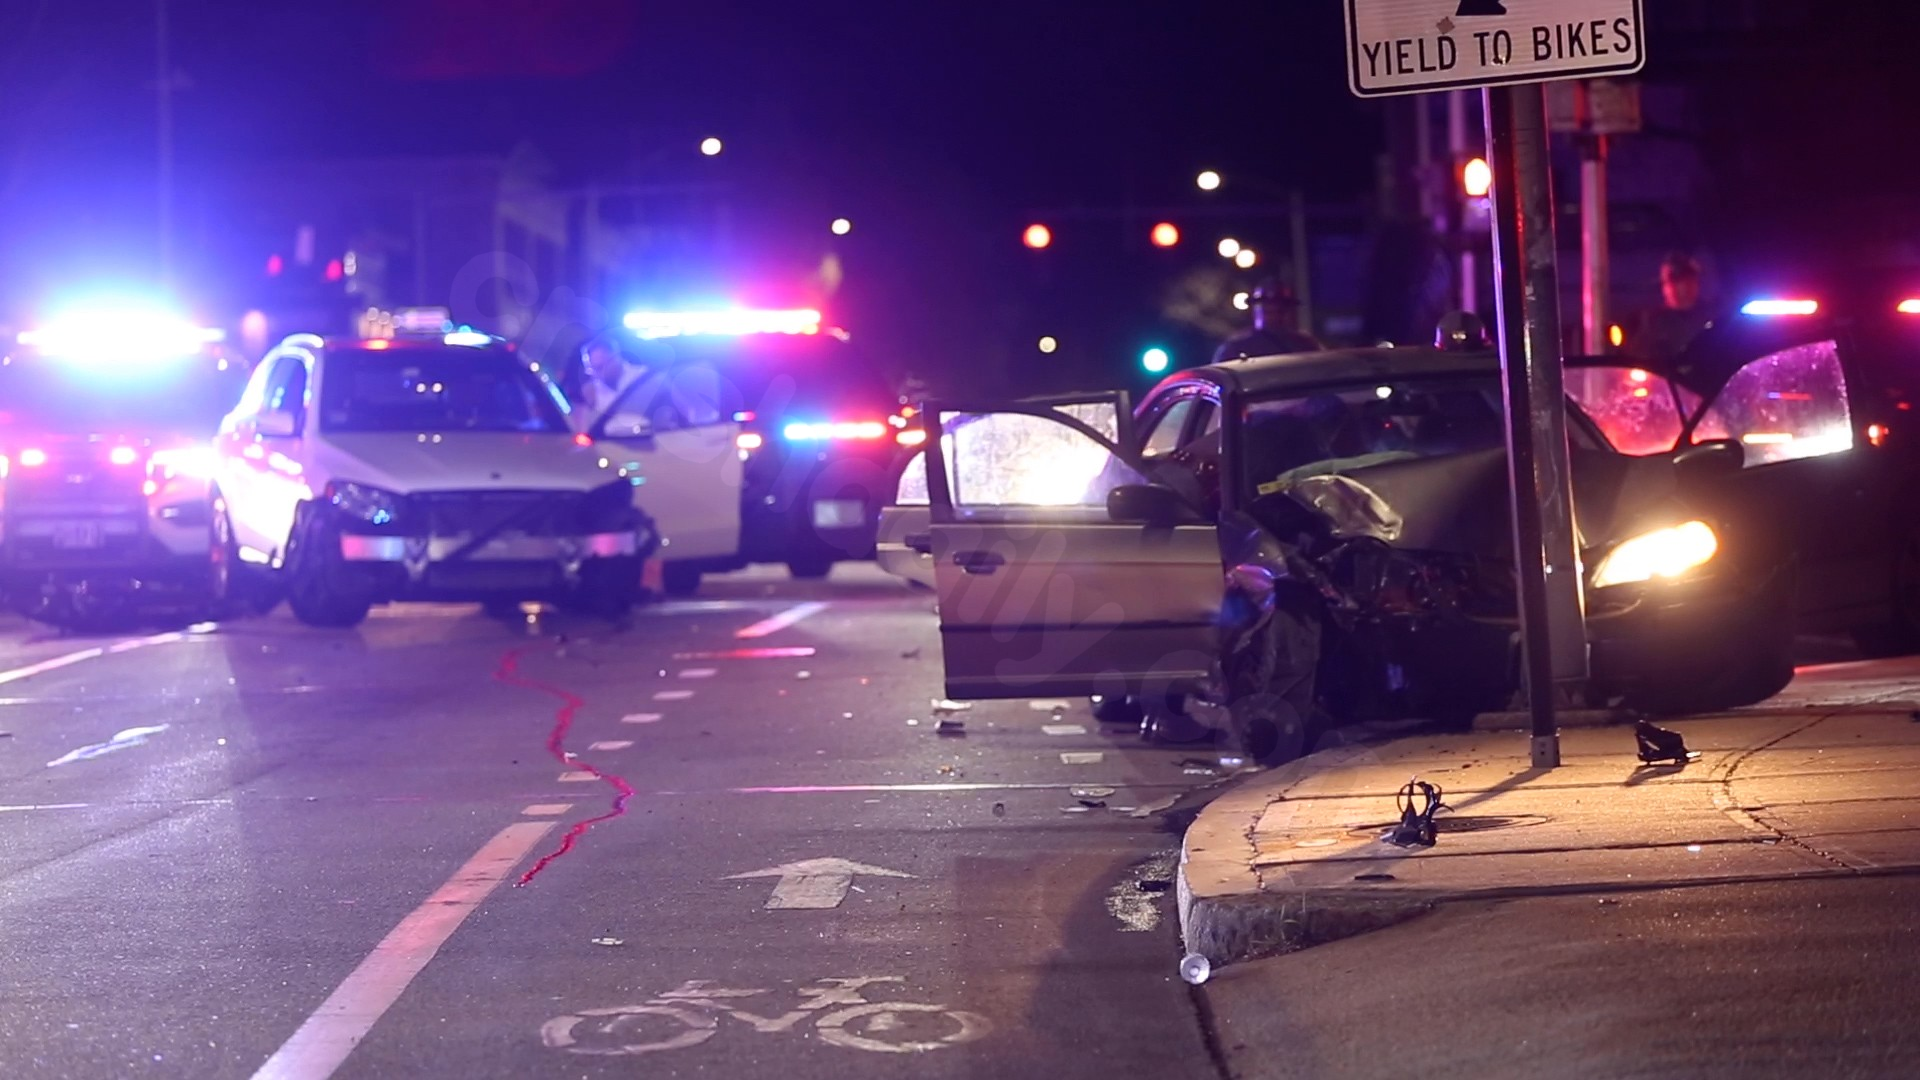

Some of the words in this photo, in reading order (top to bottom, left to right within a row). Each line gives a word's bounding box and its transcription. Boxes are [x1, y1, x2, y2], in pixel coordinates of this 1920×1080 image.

[1362, 35, 1457, 77] YIELD
[1473, 30, 1512, 67] TO
[1532, 18, 1632, 62] BIKES
